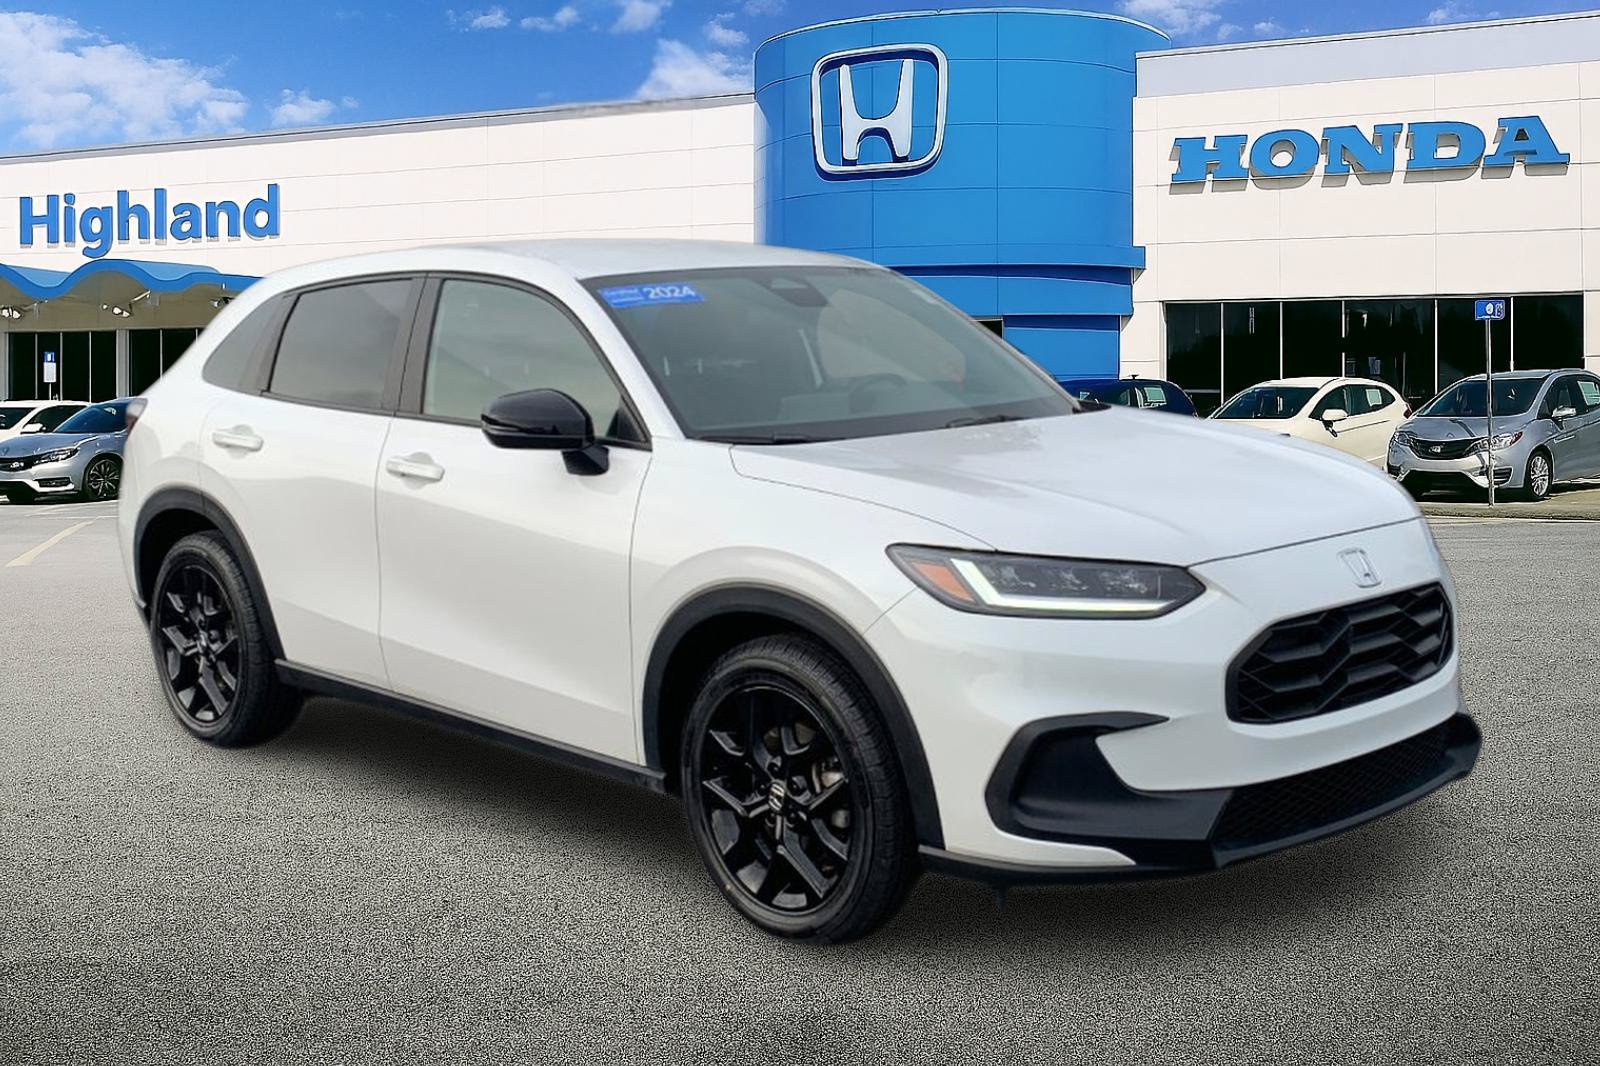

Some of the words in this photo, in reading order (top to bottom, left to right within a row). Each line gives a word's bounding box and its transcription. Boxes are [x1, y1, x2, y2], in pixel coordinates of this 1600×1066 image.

[1171, 115, 1571, 184] HONDA
[19, 183, 279, 259] Highland
[643, 285, 696, 300] 2024
